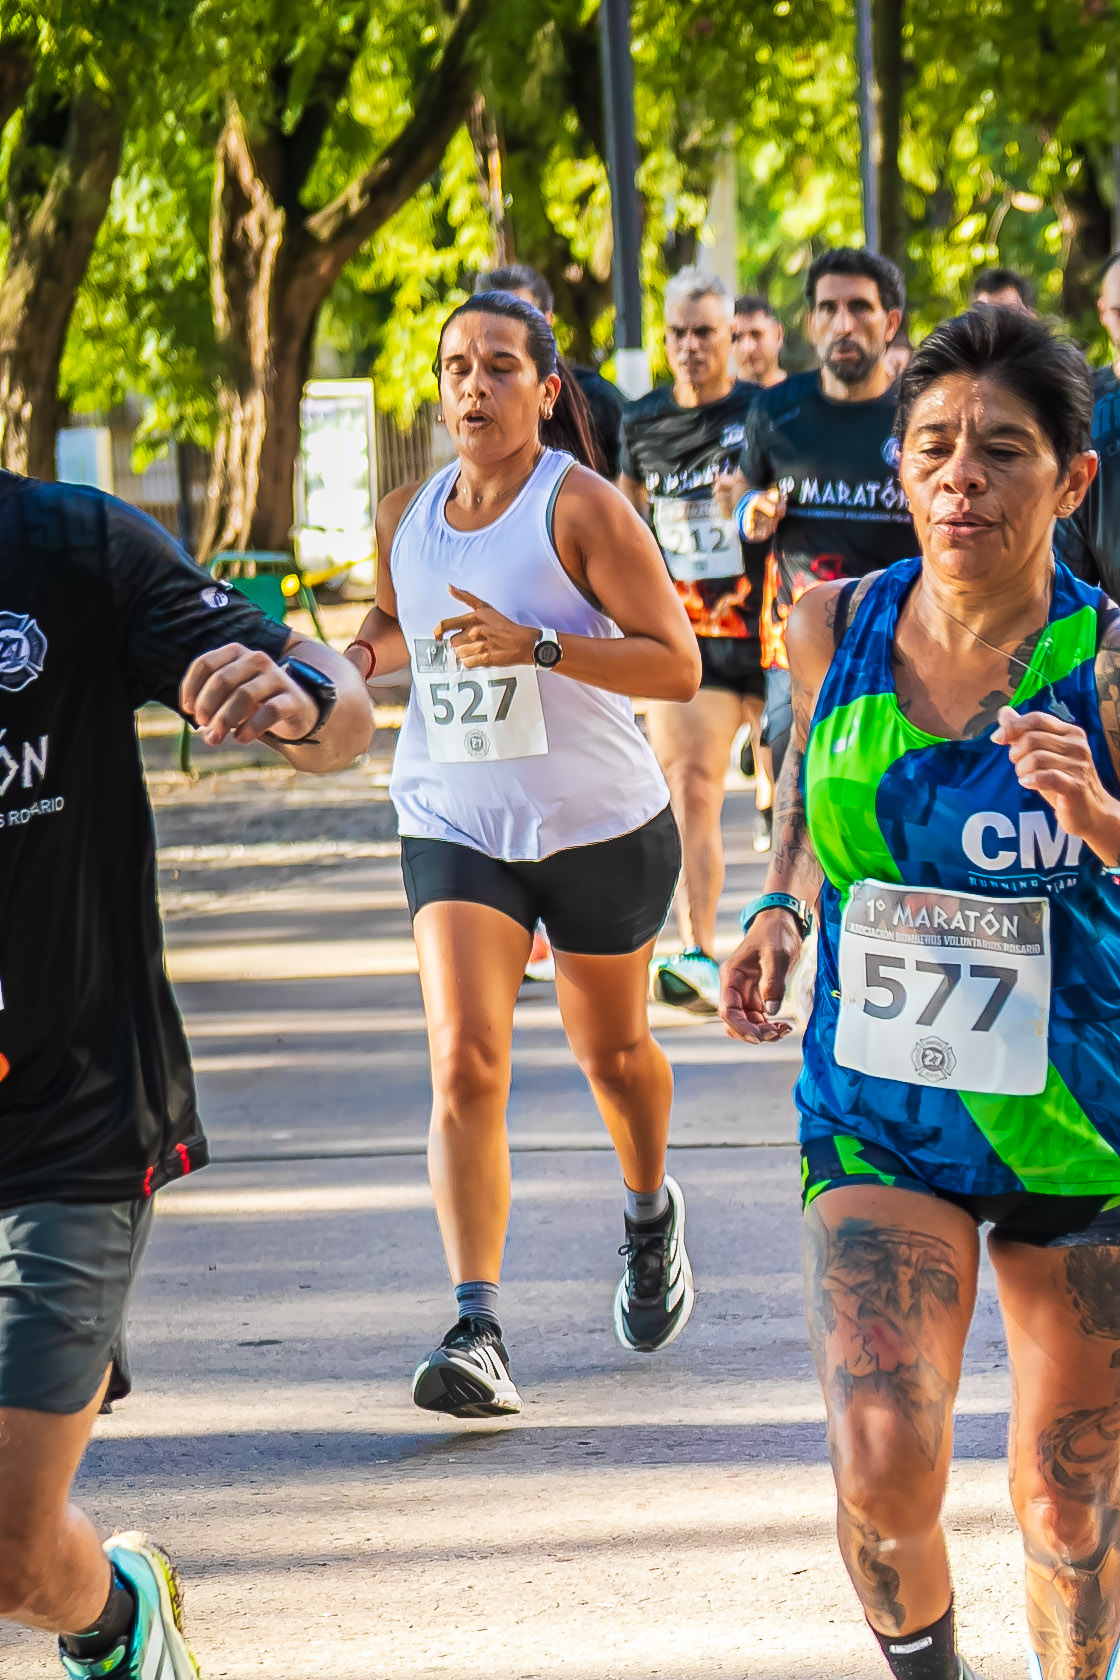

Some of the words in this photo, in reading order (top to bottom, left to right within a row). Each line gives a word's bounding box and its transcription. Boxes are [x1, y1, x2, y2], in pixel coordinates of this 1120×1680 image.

[430, 677, 517, 725] 527
[8, 796, 65, 827] ROARIO
[961, 810, 1083, 871] CM
[892, 902, 1019, 938] MARATÓN
[862, 952, 1019, 1033] 577
